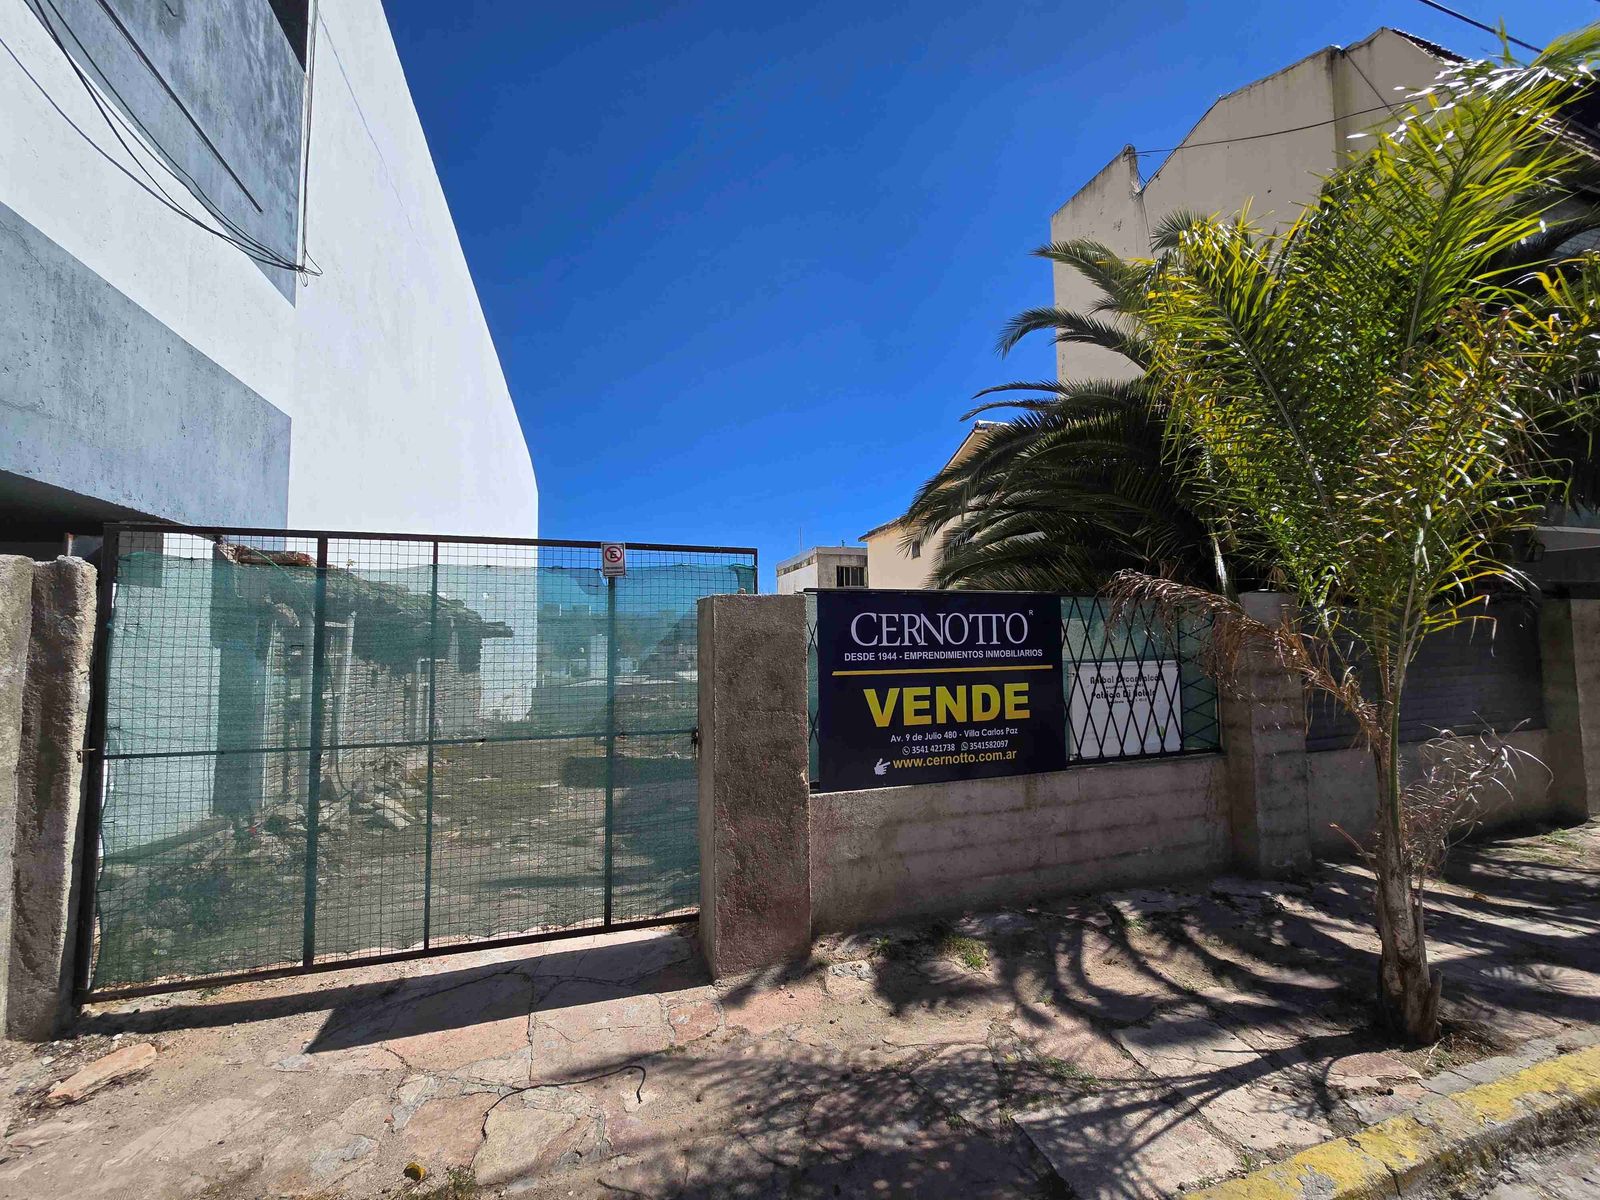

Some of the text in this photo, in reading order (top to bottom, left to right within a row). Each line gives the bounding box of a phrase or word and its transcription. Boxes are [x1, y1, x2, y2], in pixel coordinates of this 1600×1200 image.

[850, 612, 1029, 647] CERNOTTO
[844, 652, 876, 662] DESDE
[878, 651, 897, 661] 1944
[904, 650, 984, 661] EMPRENDIMIENTOS
[985, 649, 1043, 659] INMOBILIARIOS
[1090, 675, 1114, 684] Anbal
[1092, 690, 1120, 699] Patrica
[863, 682, 1031, 728] VENDE
[890, 734, 904, 743] Av.
[905, 733, 911, 742] 9
[912, 732, 923, 742] de
[924, 732, 942, 741] Julio
[943, 730, 958, 740] 480
[963, 729, 980, 738] Villa
[981, 727, 1004, 737] Carlos
[1005, 727, 1019, 735] Paz
[911, 739, 1009, 754] 3541 421738 3541582097
[892, 750, 1018, 769] www.cernotto.com.ar
